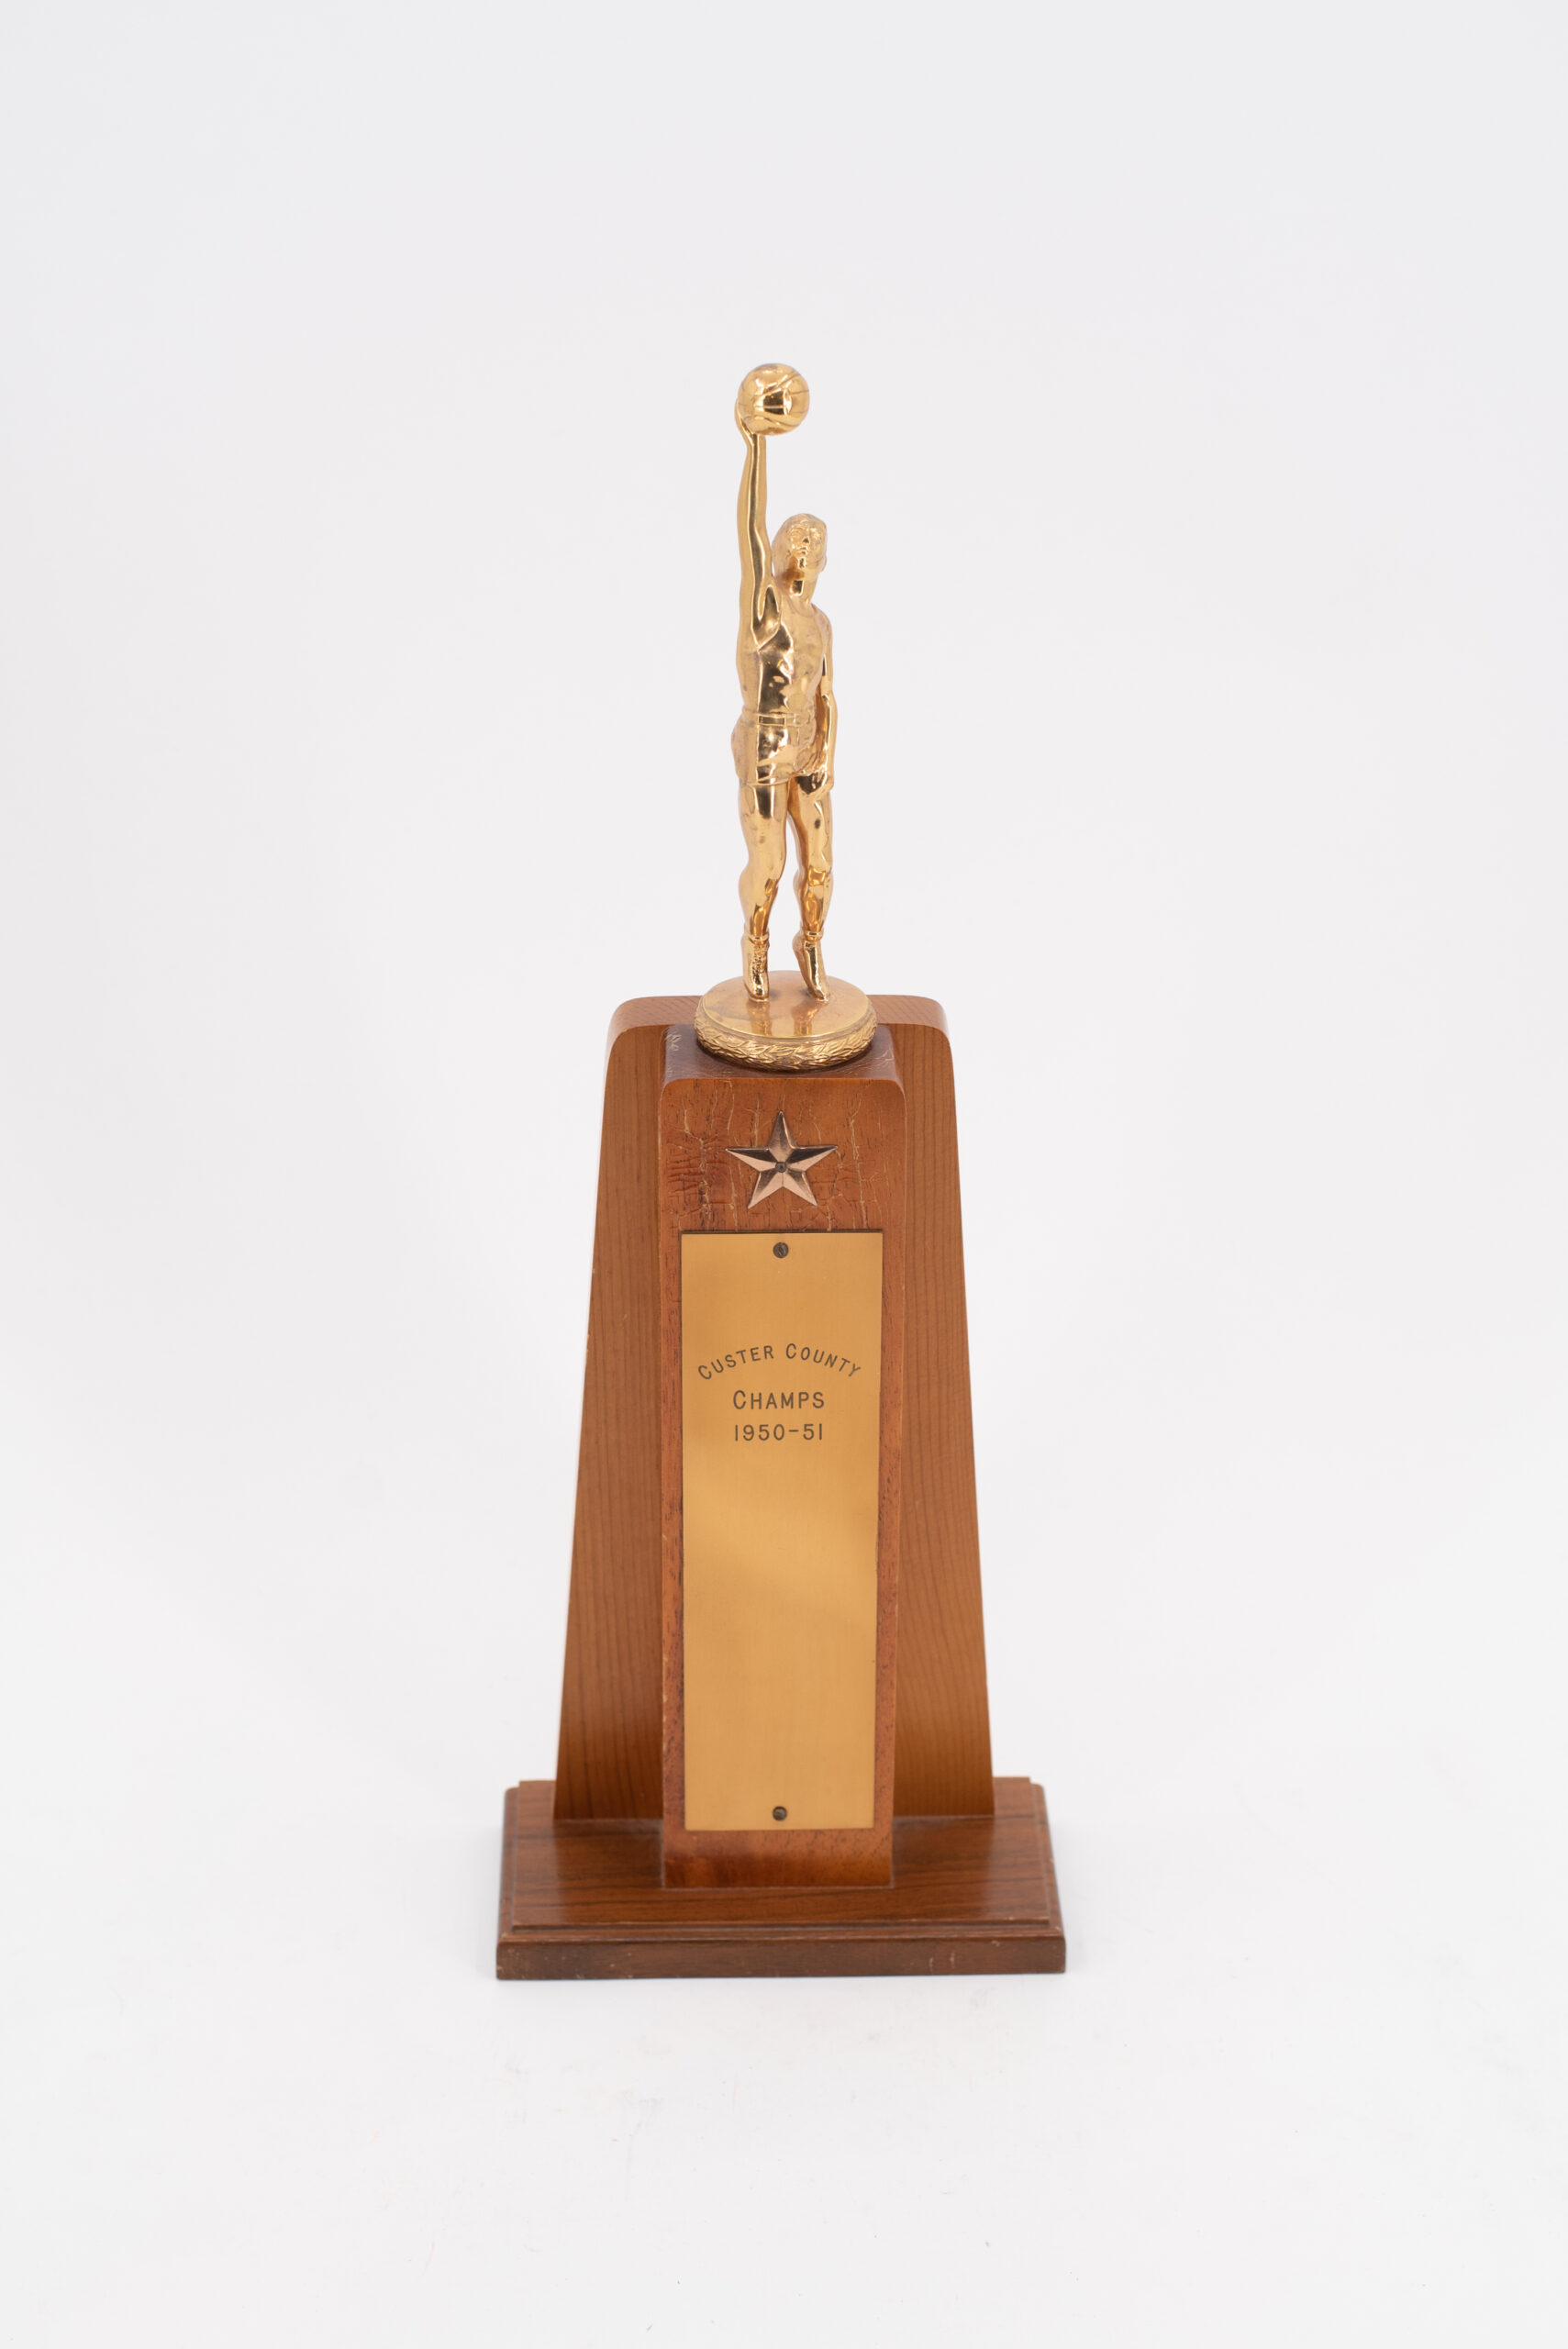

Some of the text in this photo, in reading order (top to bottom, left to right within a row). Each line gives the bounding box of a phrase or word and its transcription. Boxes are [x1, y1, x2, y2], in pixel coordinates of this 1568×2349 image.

[697, 1342, 862, 1380] CUSTER COUNTY
[733, 1389, 825, 1410] CHAMPS
[735, 1423, 823, 1442] 1950-51
